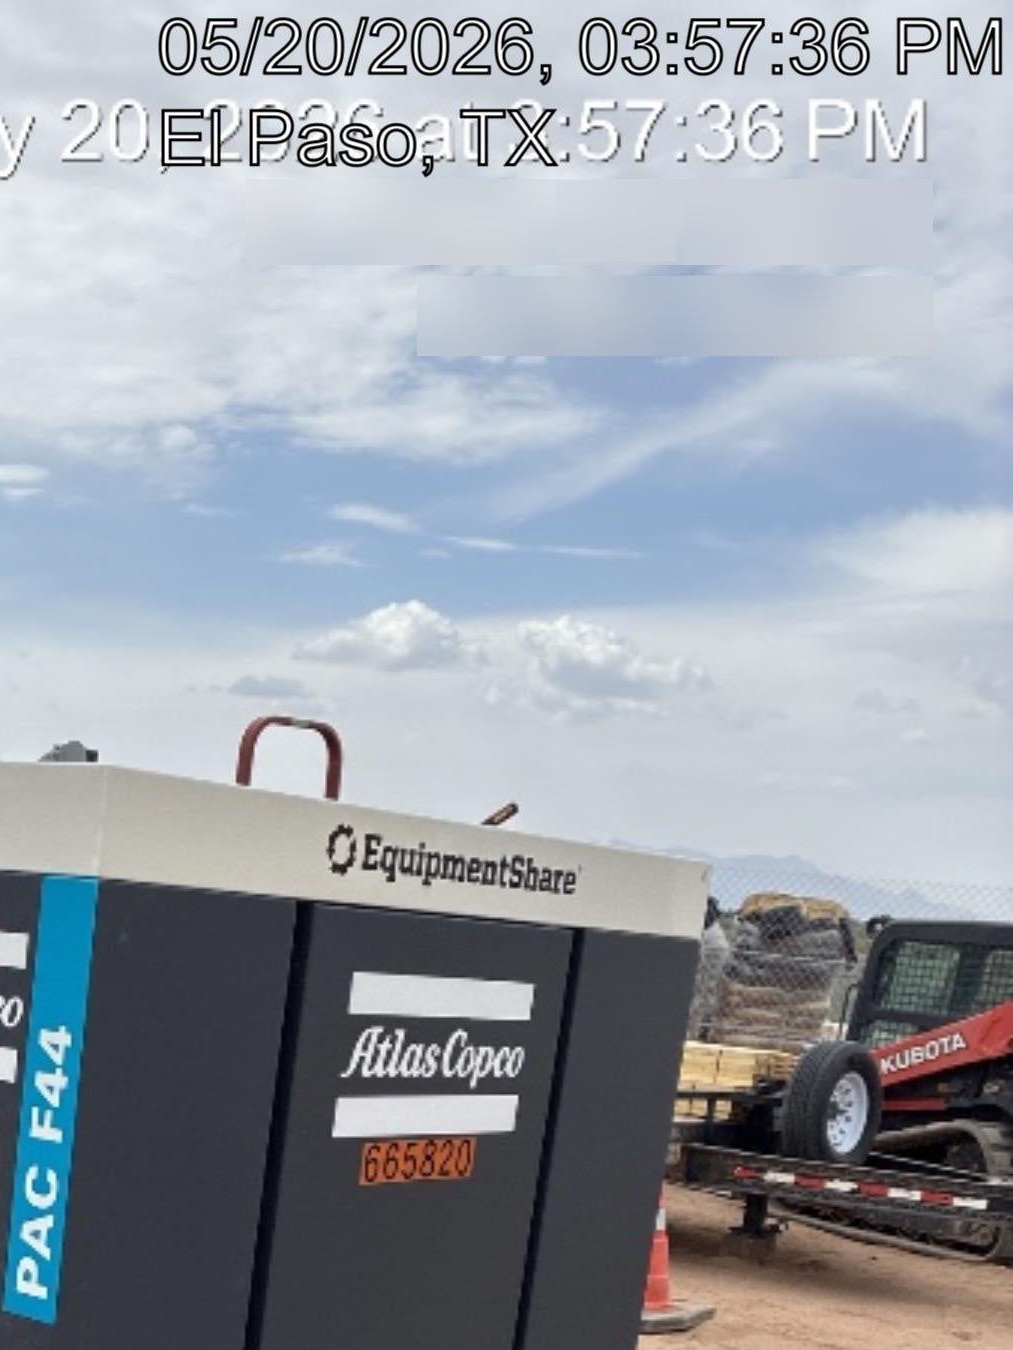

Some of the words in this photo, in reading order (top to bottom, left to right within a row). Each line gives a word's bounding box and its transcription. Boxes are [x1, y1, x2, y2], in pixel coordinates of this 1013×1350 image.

[361, 833, 577, 895] EquipmentShare
[29, 1025, 73, 1144] F44
[340, 1025, 441, 1079] Atlas
[441, 1028, 526, 1090] Copco
[880, 1032, 967, 1075] KUBOTA
[364, 1139, 471, 1183] 665820
[16, 1164, 58, 1300] PAC
